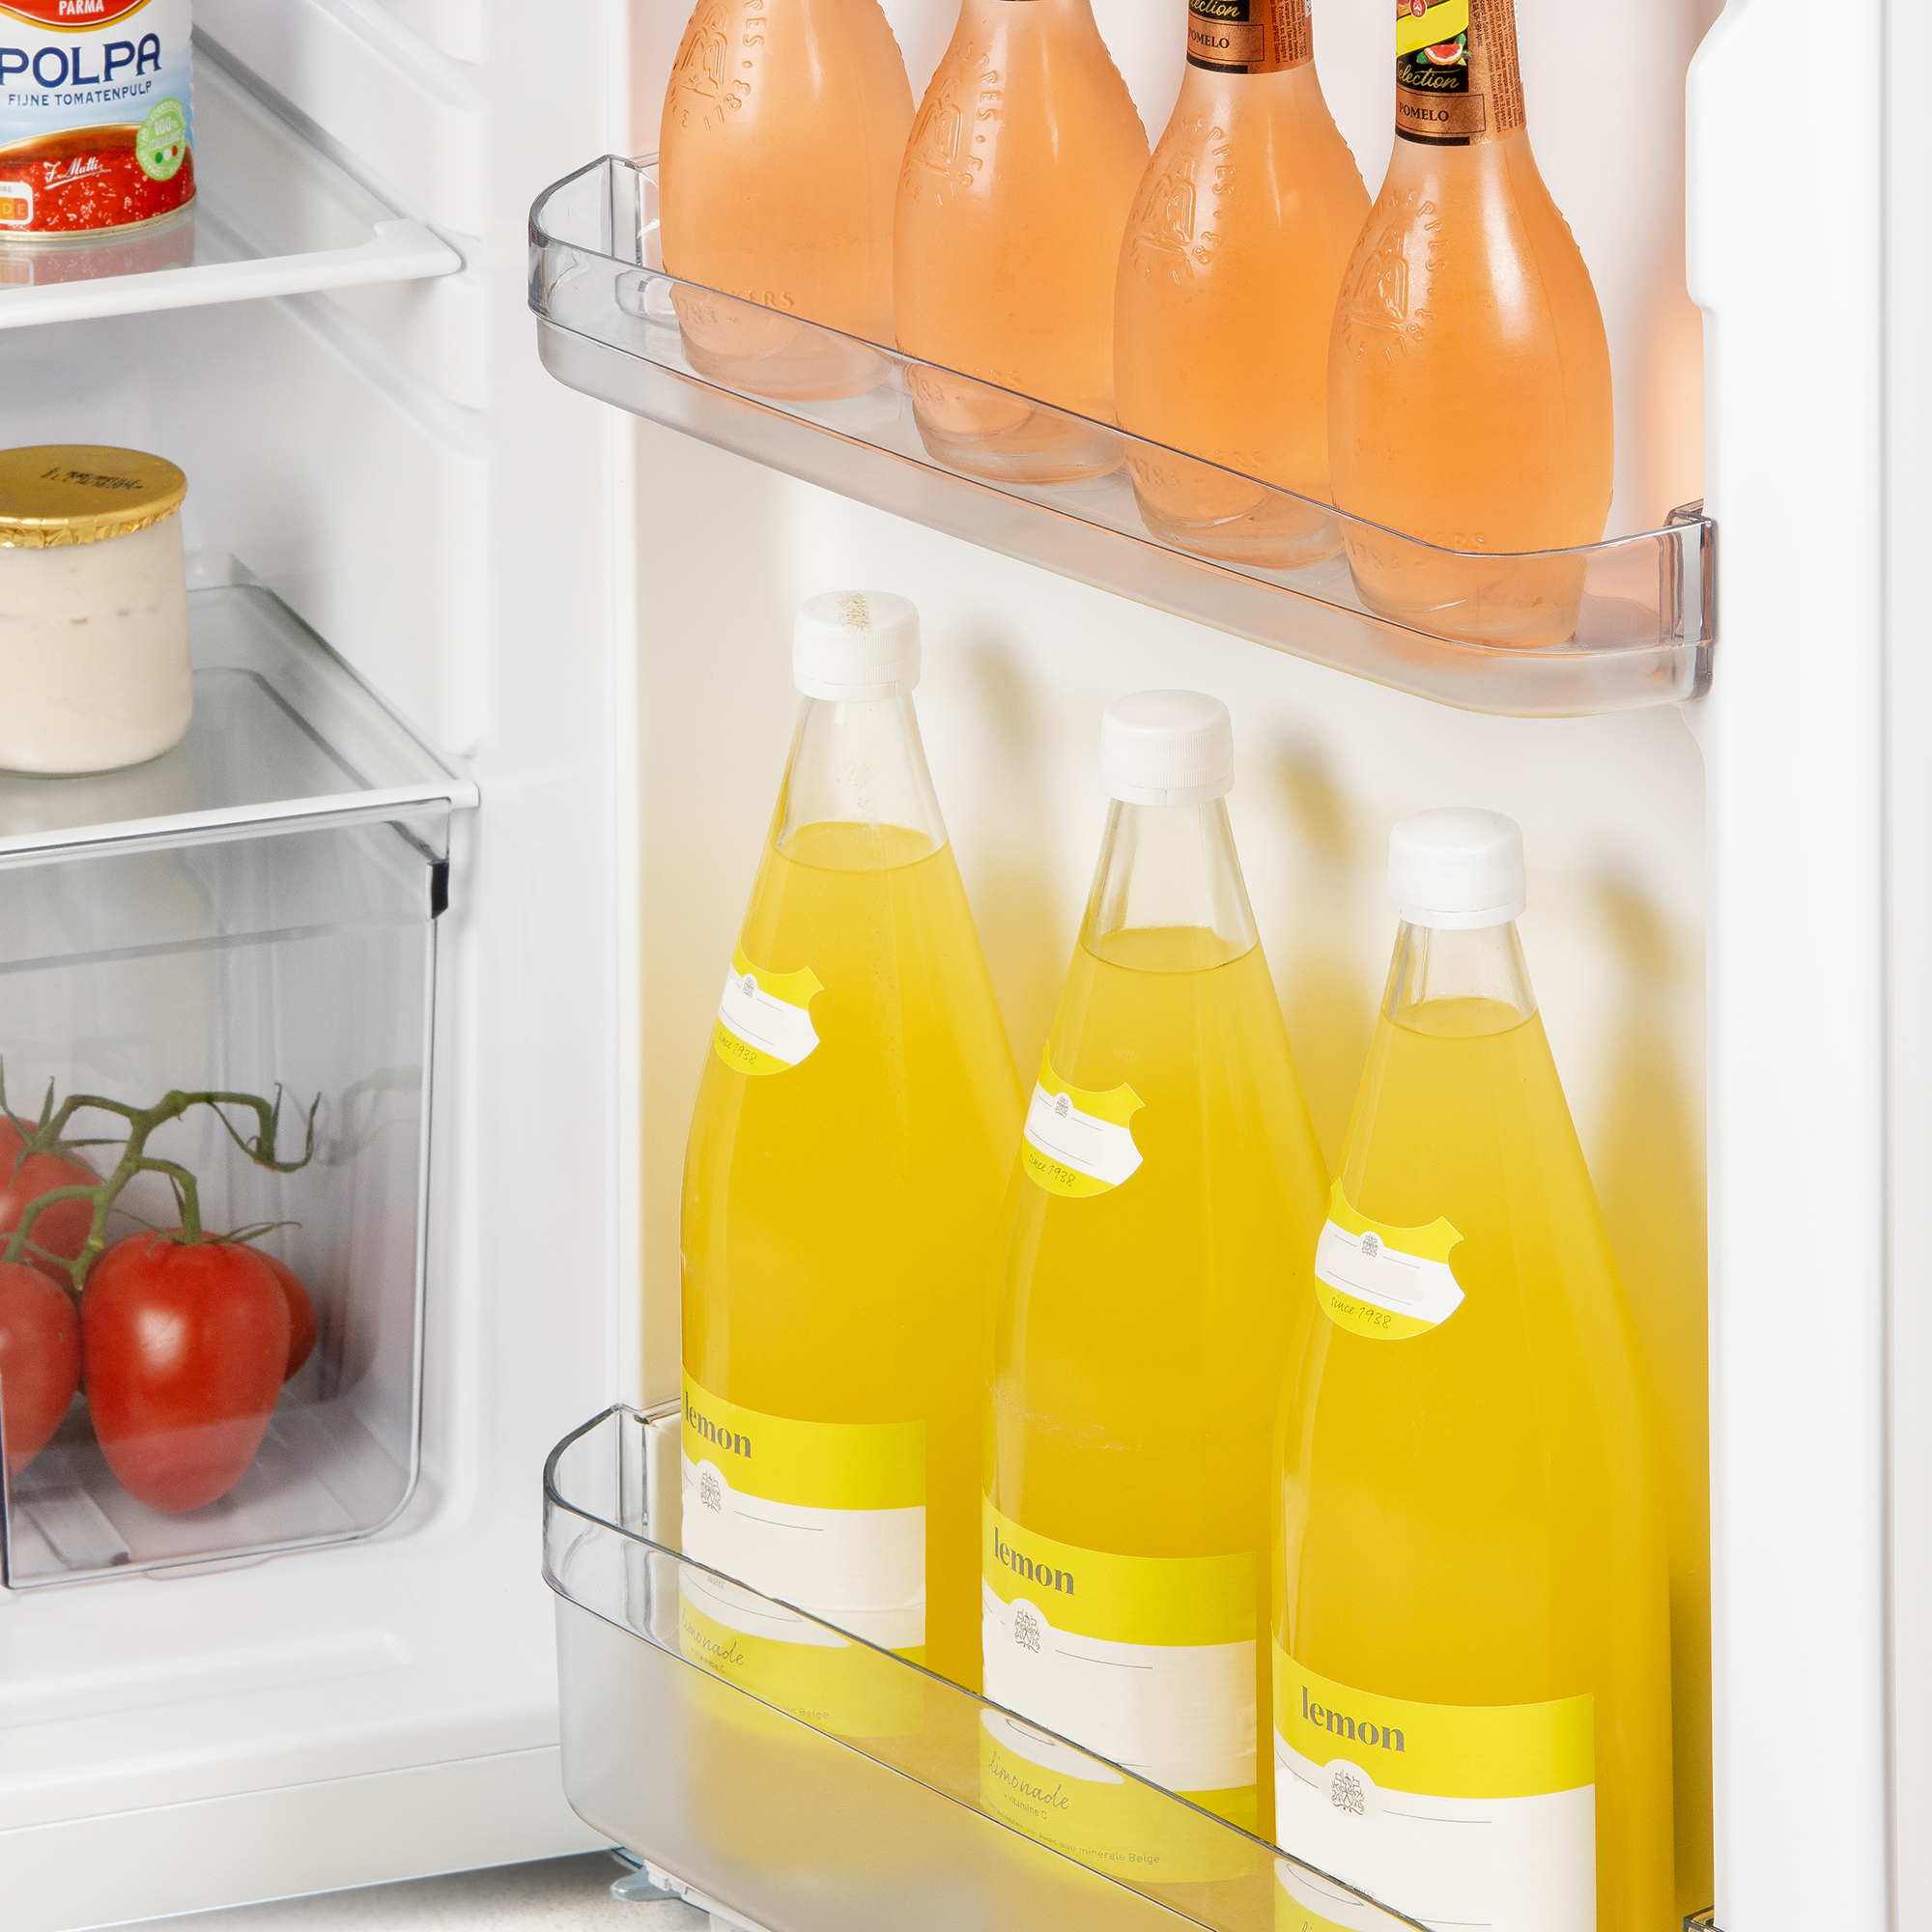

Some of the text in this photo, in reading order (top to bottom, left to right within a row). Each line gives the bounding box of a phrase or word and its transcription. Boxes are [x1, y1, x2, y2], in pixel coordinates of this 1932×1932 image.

[59, 0, 104, 15] PARMA
[1188, 27, 1230, 48] POMELO
[0, 33, 162, 89] POLPA
[9, 80, 153, 106] FIJNE TOMATENPULP
[1399, 101, 1450, 122] POMELO
[2, 203, 26, 215] D E
[733, 1043, 757, 1065] 1938
[1028, 1151, 1076, 1187] since 1938
[1330, 1294, 1392, 1329] since 1938
[685, 1391, 753, 1460] lemon
[993, 1525, 1075, 1595] lemon
[799, 1708, 829, 1719] Belge
[1301, 1685, 1406, 1752] lemon
[988, 1750, 1068, 1809] limonade
[1008, 1795, 1039, 1817] vitamine
[1040, 1809, 1047, 1820] C
[1060, 1841, 1076, 1852] eau
[1078, 1847, 1125, 1861] minérale
[1128, 1853, 1160, 1865] Belge
